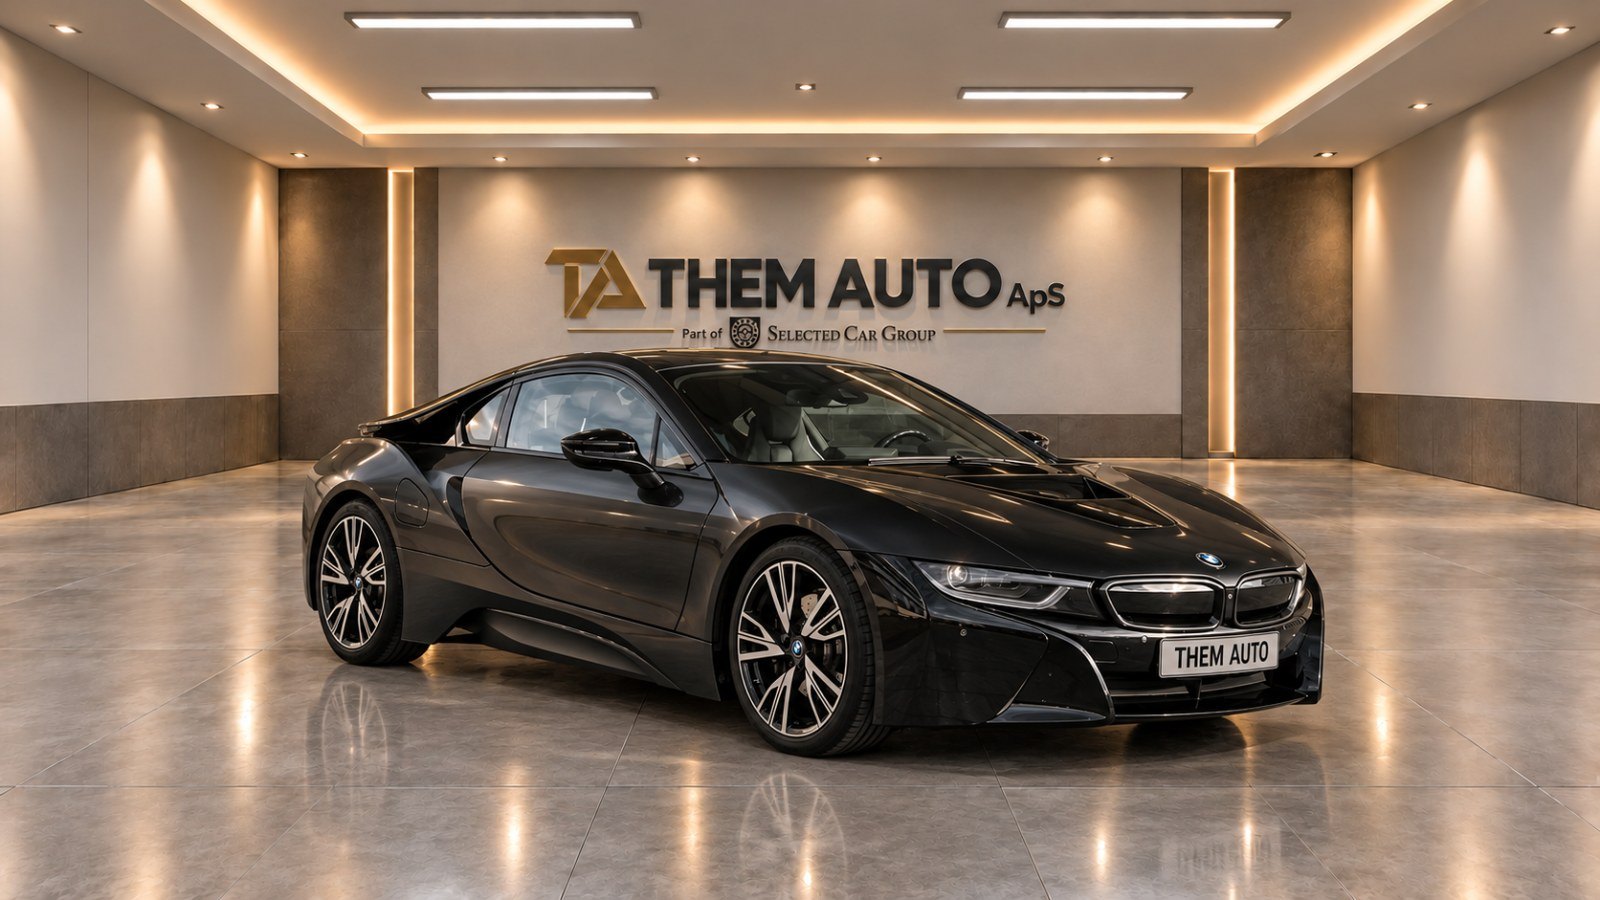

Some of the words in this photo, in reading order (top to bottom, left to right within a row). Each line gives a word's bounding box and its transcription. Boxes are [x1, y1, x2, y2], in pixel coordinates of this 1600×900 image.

[648, 258, 816, 308] THEM
[827, 258, 1003, 308] AUTO
[1006, 283, 1065, 314] ApS
[682, 328, 707, 340] Part
[710, 327, 723, 340] of
[1174, 645, 1224, 668] THEM
[1229, 641, 1268, 665] AUTO
